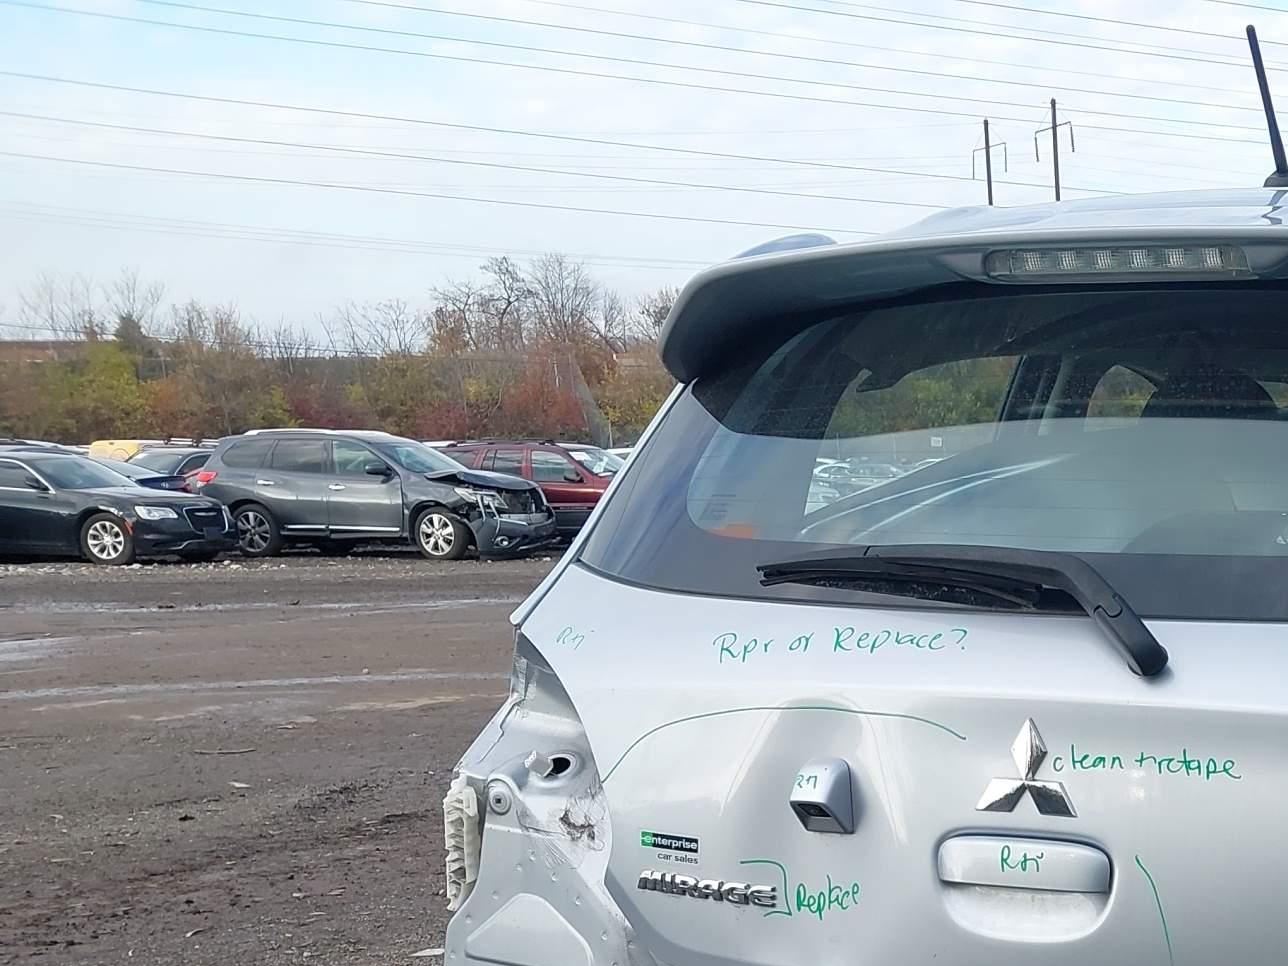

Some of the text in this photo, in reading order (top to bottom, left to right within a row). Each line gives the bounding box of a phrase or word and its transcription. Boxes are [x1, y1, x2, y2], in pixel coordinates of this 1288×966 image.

[788, 632, 815, 652] or
[641, 835, 698, 850] enterprise
[657, 853, 698, 865] car sales
[638, 870, 777, 908] MIRAGE
